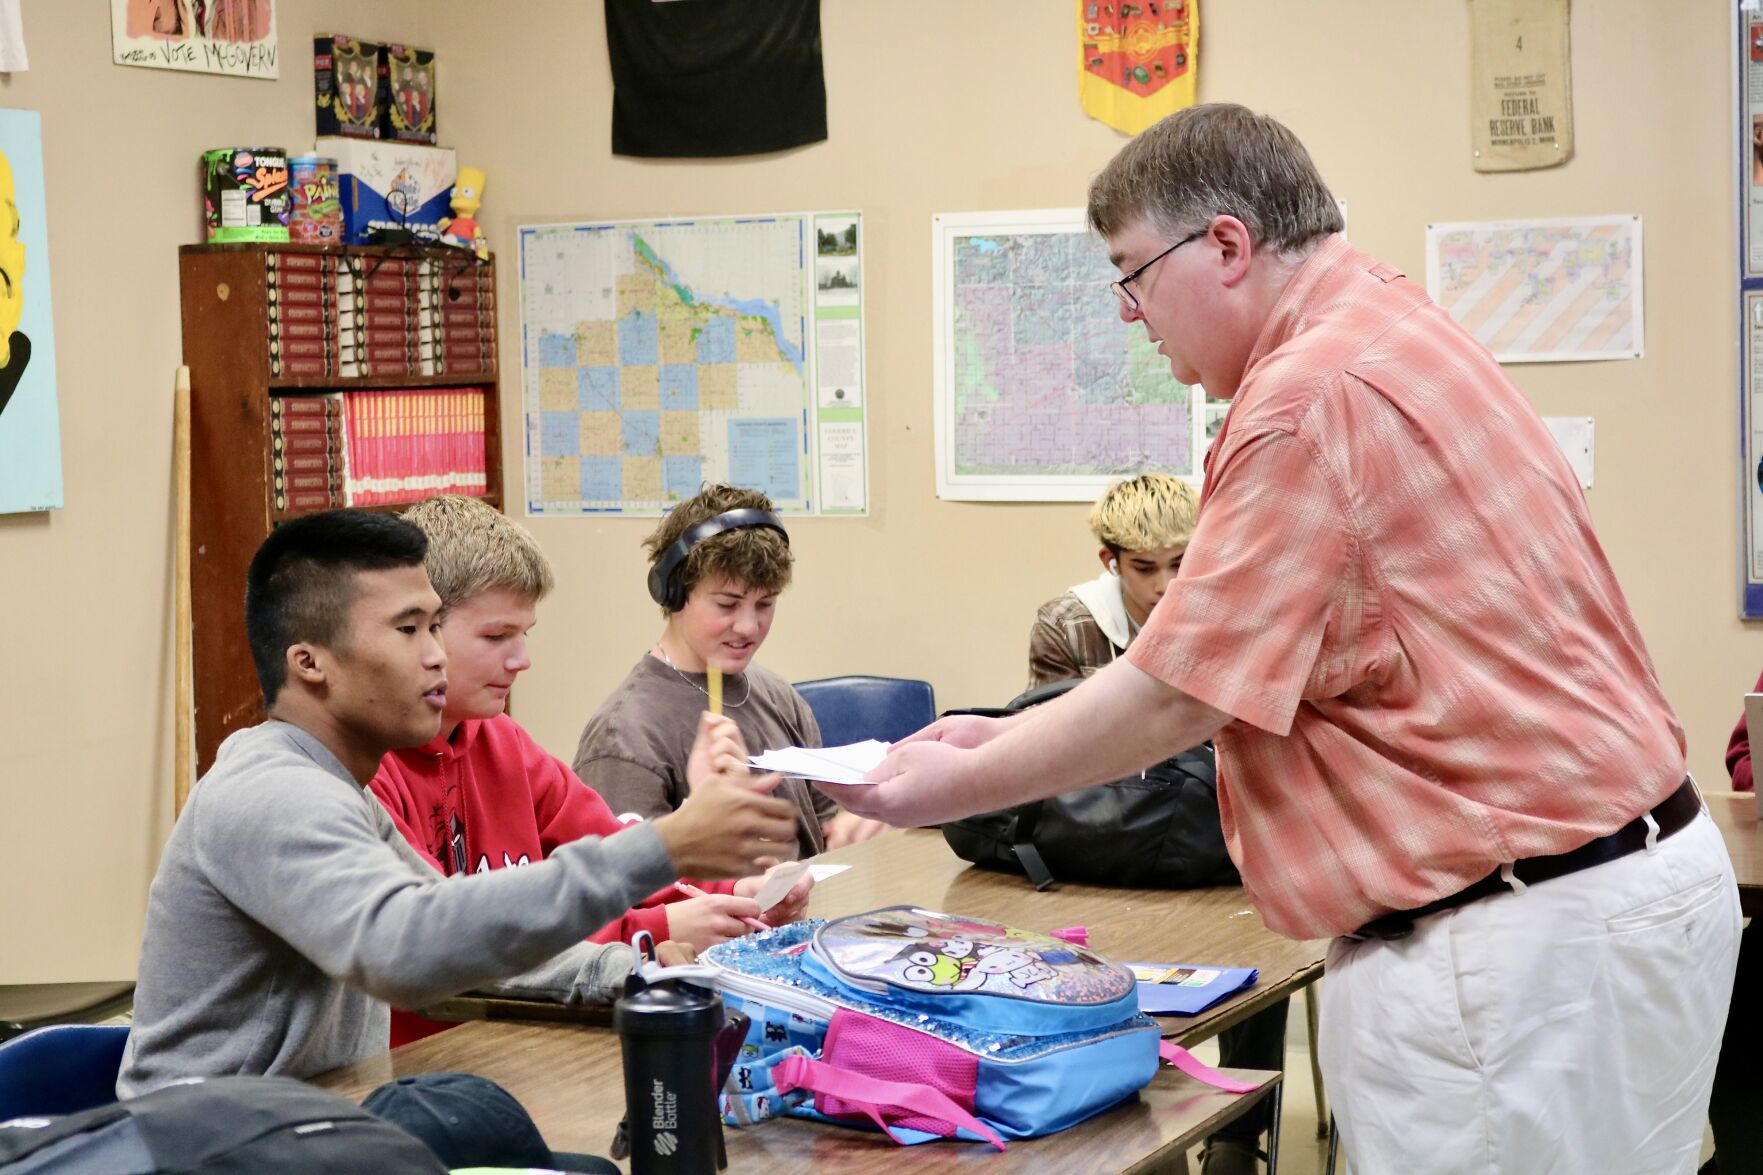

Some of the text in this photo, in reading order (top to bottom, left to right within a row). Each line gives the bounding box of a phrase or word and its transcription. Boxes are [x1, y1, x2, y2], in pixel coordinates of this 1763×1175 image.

[160, 38, 196, 64] VOTE
[1515, 35, 1523, 51] 4
[1501, 98, 1540, 117] FEDERAL
[1489, 115, 1556, 137] RESERVE BANK
[651, 1079, 664, 1129] Blender
[664, 1092, 677, 1129] Bottle
